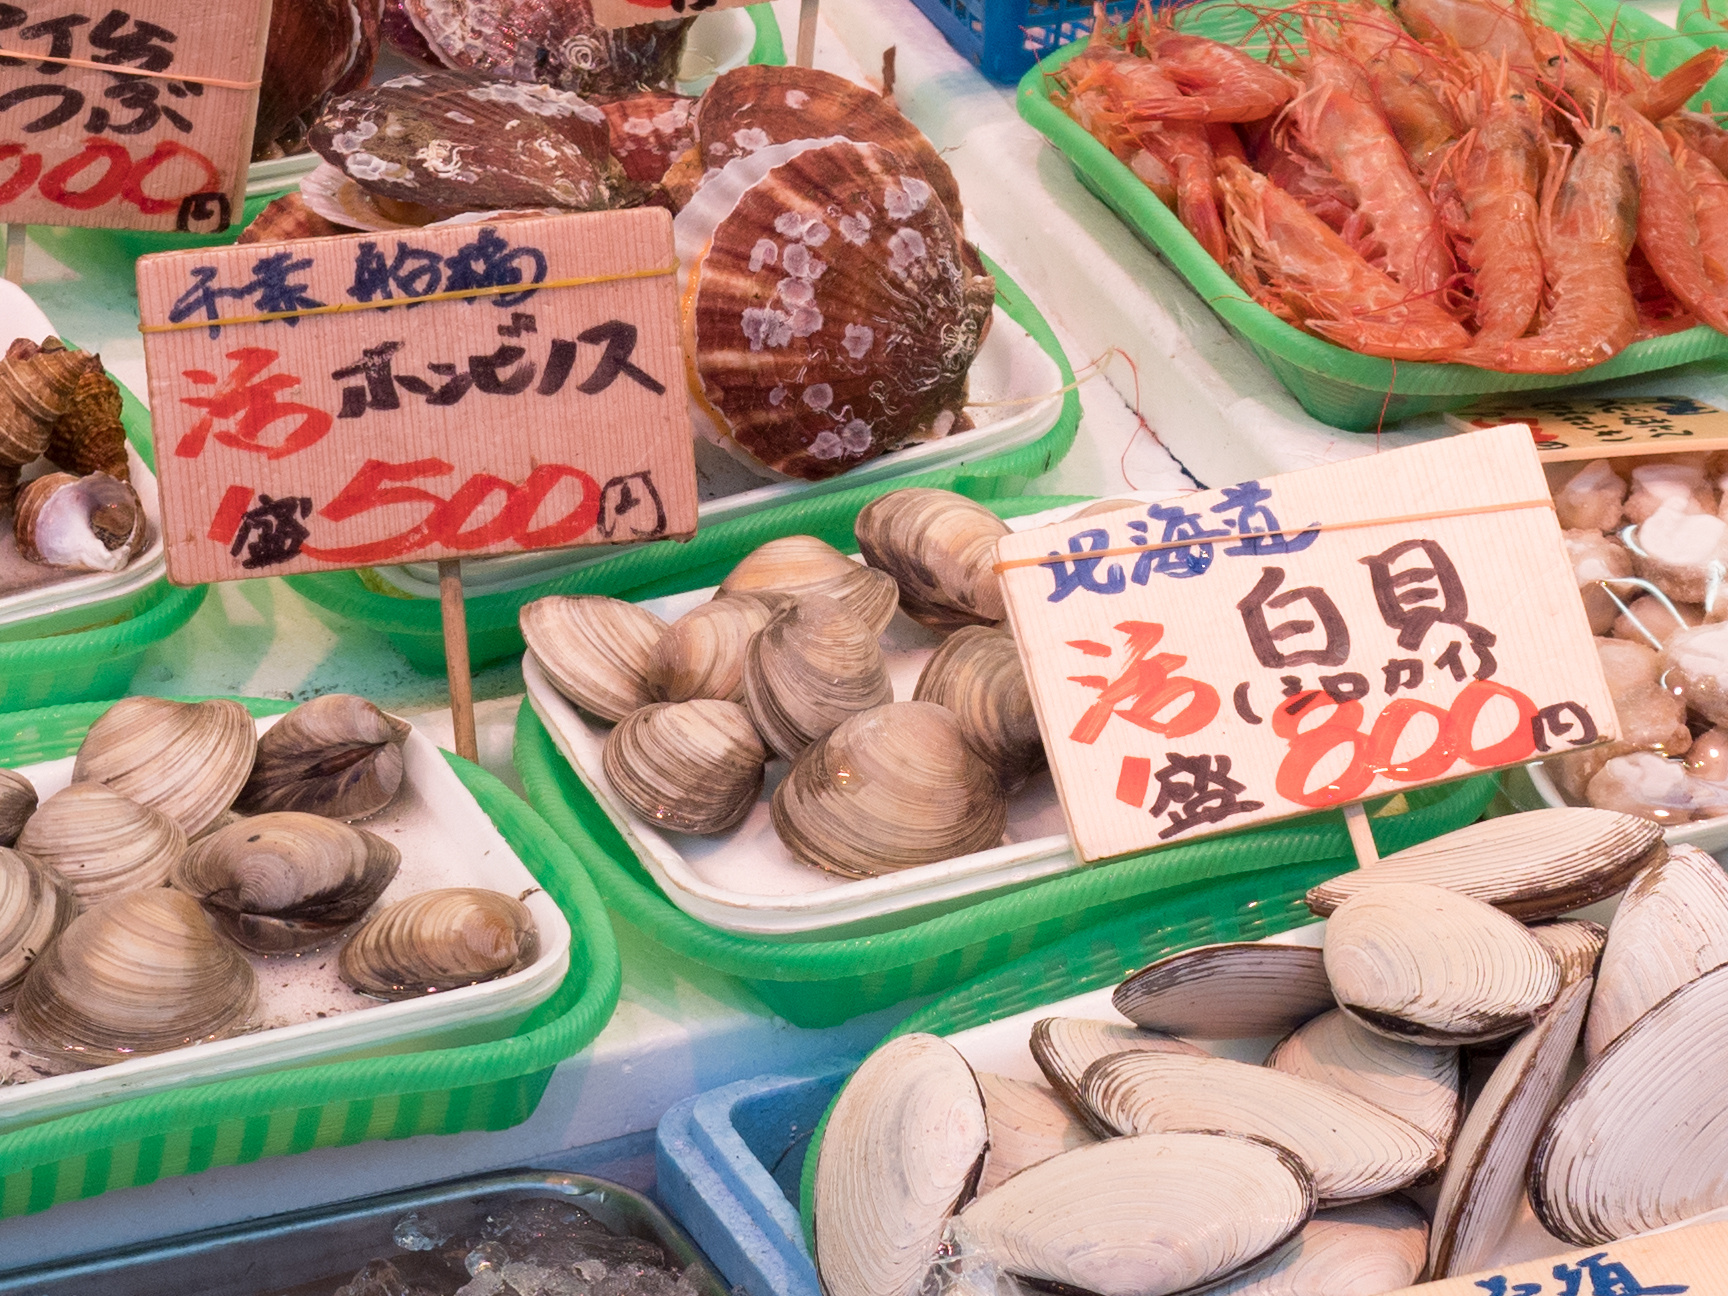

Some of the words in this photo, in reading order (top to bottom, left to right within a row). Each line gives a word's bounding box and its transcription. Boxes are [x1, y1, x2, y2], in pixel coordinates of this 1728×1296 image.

[174, 347, 333, 460] 活
[332, 313, 667, 419] ホンビノス
[1039, 480, 1322, 603] 北海道
[1236, 539, 1490, 669] 白貝
[1066, 620, 1221, 744] 活
